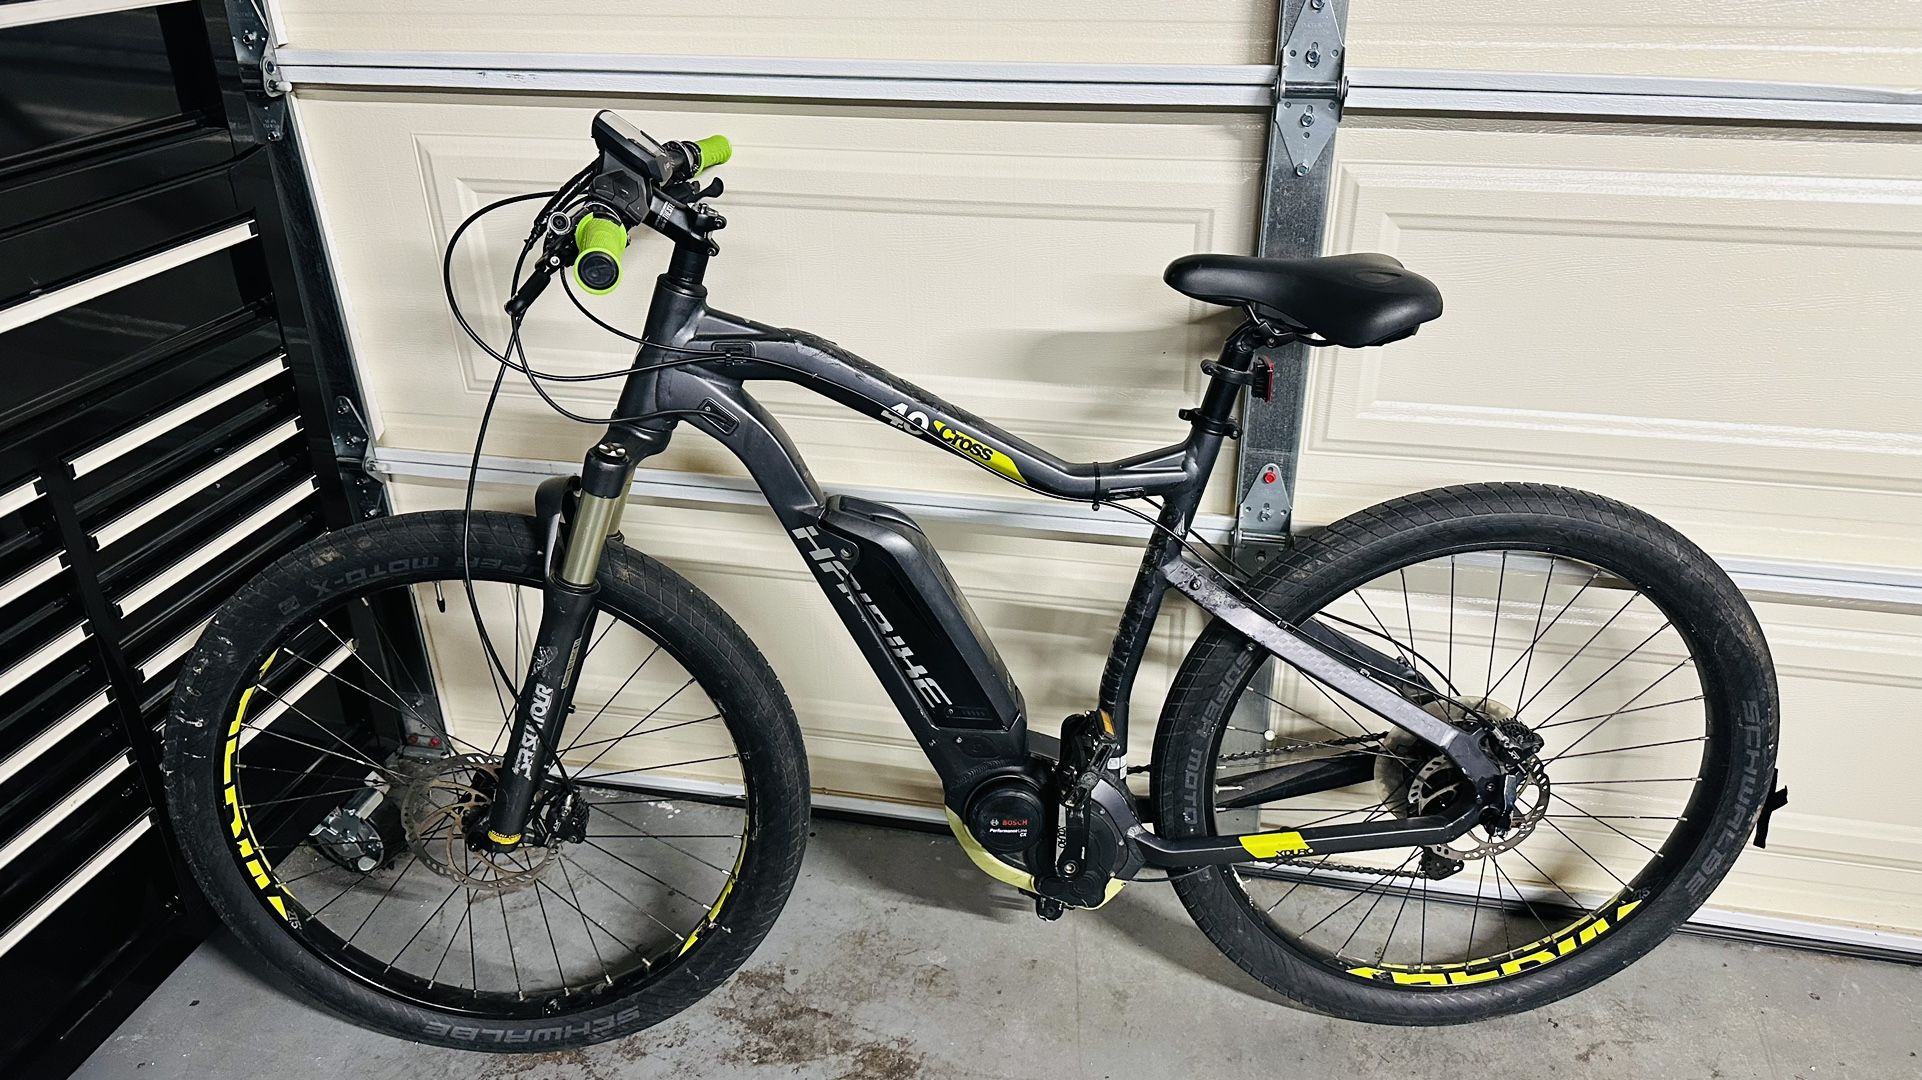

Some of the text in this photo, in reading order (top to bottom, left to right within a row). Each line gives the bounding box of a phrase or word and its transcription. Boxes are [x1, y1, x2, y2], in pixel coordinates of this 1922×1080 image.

[938, 424, 994, 462] Cross
[1685, 700, 1762, 897] SCHWALBE
[1001, 818, 1028, 826] BOSCH
[423, 1005, 641, 1044] SCHWALBE
